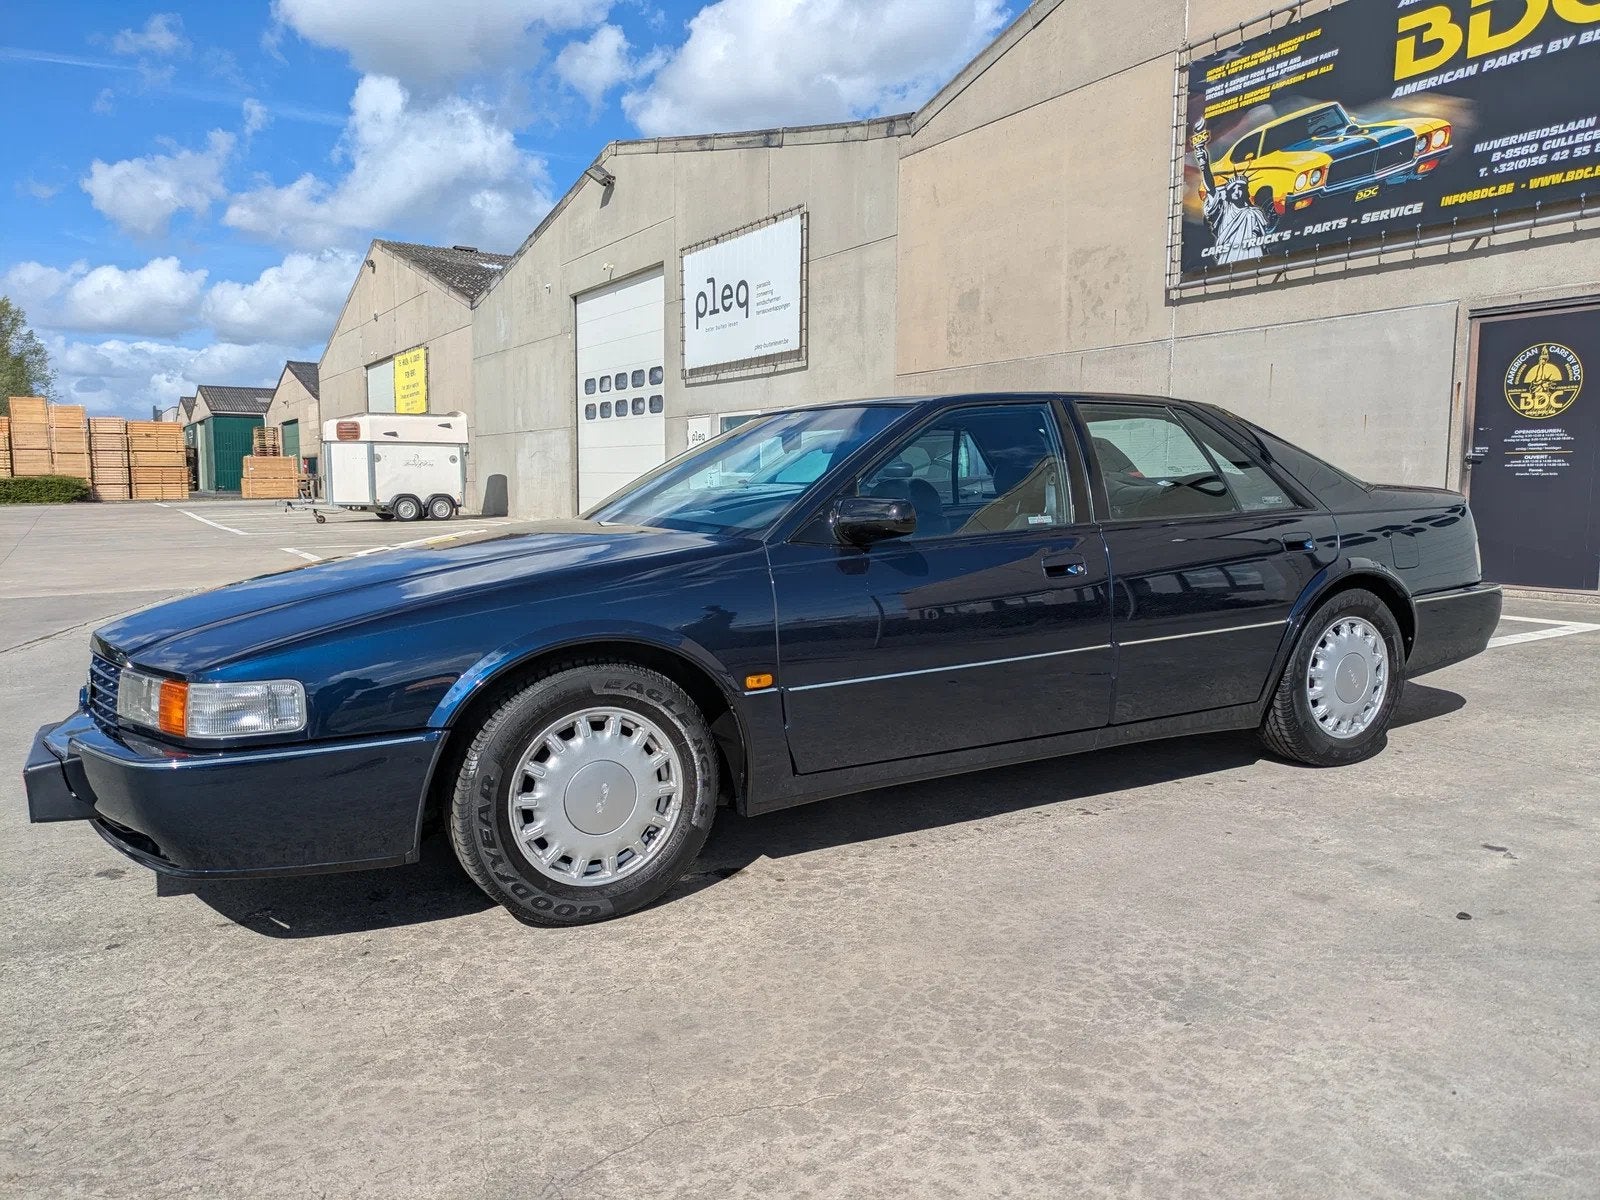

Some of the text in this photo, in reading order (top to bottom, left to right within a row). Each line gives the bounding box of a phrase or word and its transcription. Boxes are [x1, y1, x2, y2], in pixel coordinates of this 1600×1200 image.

[1266, 46, 1276, 55] ALL
[1277, 35, 1306, 50] AMERICAN
[1306, 28, 1322, 40] CARS
[1280, 43, 1299, 56] TODAY
[1265, 65, 1275, 74] ALL
[1275, 60, 1289, 70] NEW
[1279, 55, 1320, 75] AFTERMARKET
[1319, 48, 1339, 61] PARTS
[1318, 63, 1334, 75] ALLE
[1391, 63, 1479, 99] AMERICAN
[1481, 44, 1543, 72] PARTS
[1546, 34, 1577, 54] BY
[1473, 116, 1597, 153] NIJVERHEIDSLAAN
[1478, 167, 1489, 178] T.
[1492, 153, 1549, 174] +32(0)56
[1550, 149, 1570, 162] 42
[1572, 144, 1592, 158] 55
[1491, 143, 1539, 162] B-8560
[1355, 187, 1379, 201] BDC
[1440, 181, 1515, 207] INFO@BDC.BE
[1201, 243, 1230, 258] CARS
[1242, 230, 1292, 249] TRUCK'S
[1303, 217, 1348, 237] PARTS
[1360, 202, 1424, 225] SERVICE
[695, 277, 749, 330] pleq
[1507, 345, 1581, 385] AMERICAN CARS BY BDC
[1519, 390, 1564, 410] BDC
[692, 430, 705, 444] pleq
[603, 679, 695, 731] EAGLE
[478, 774, 602, 917] GOODYEAR
